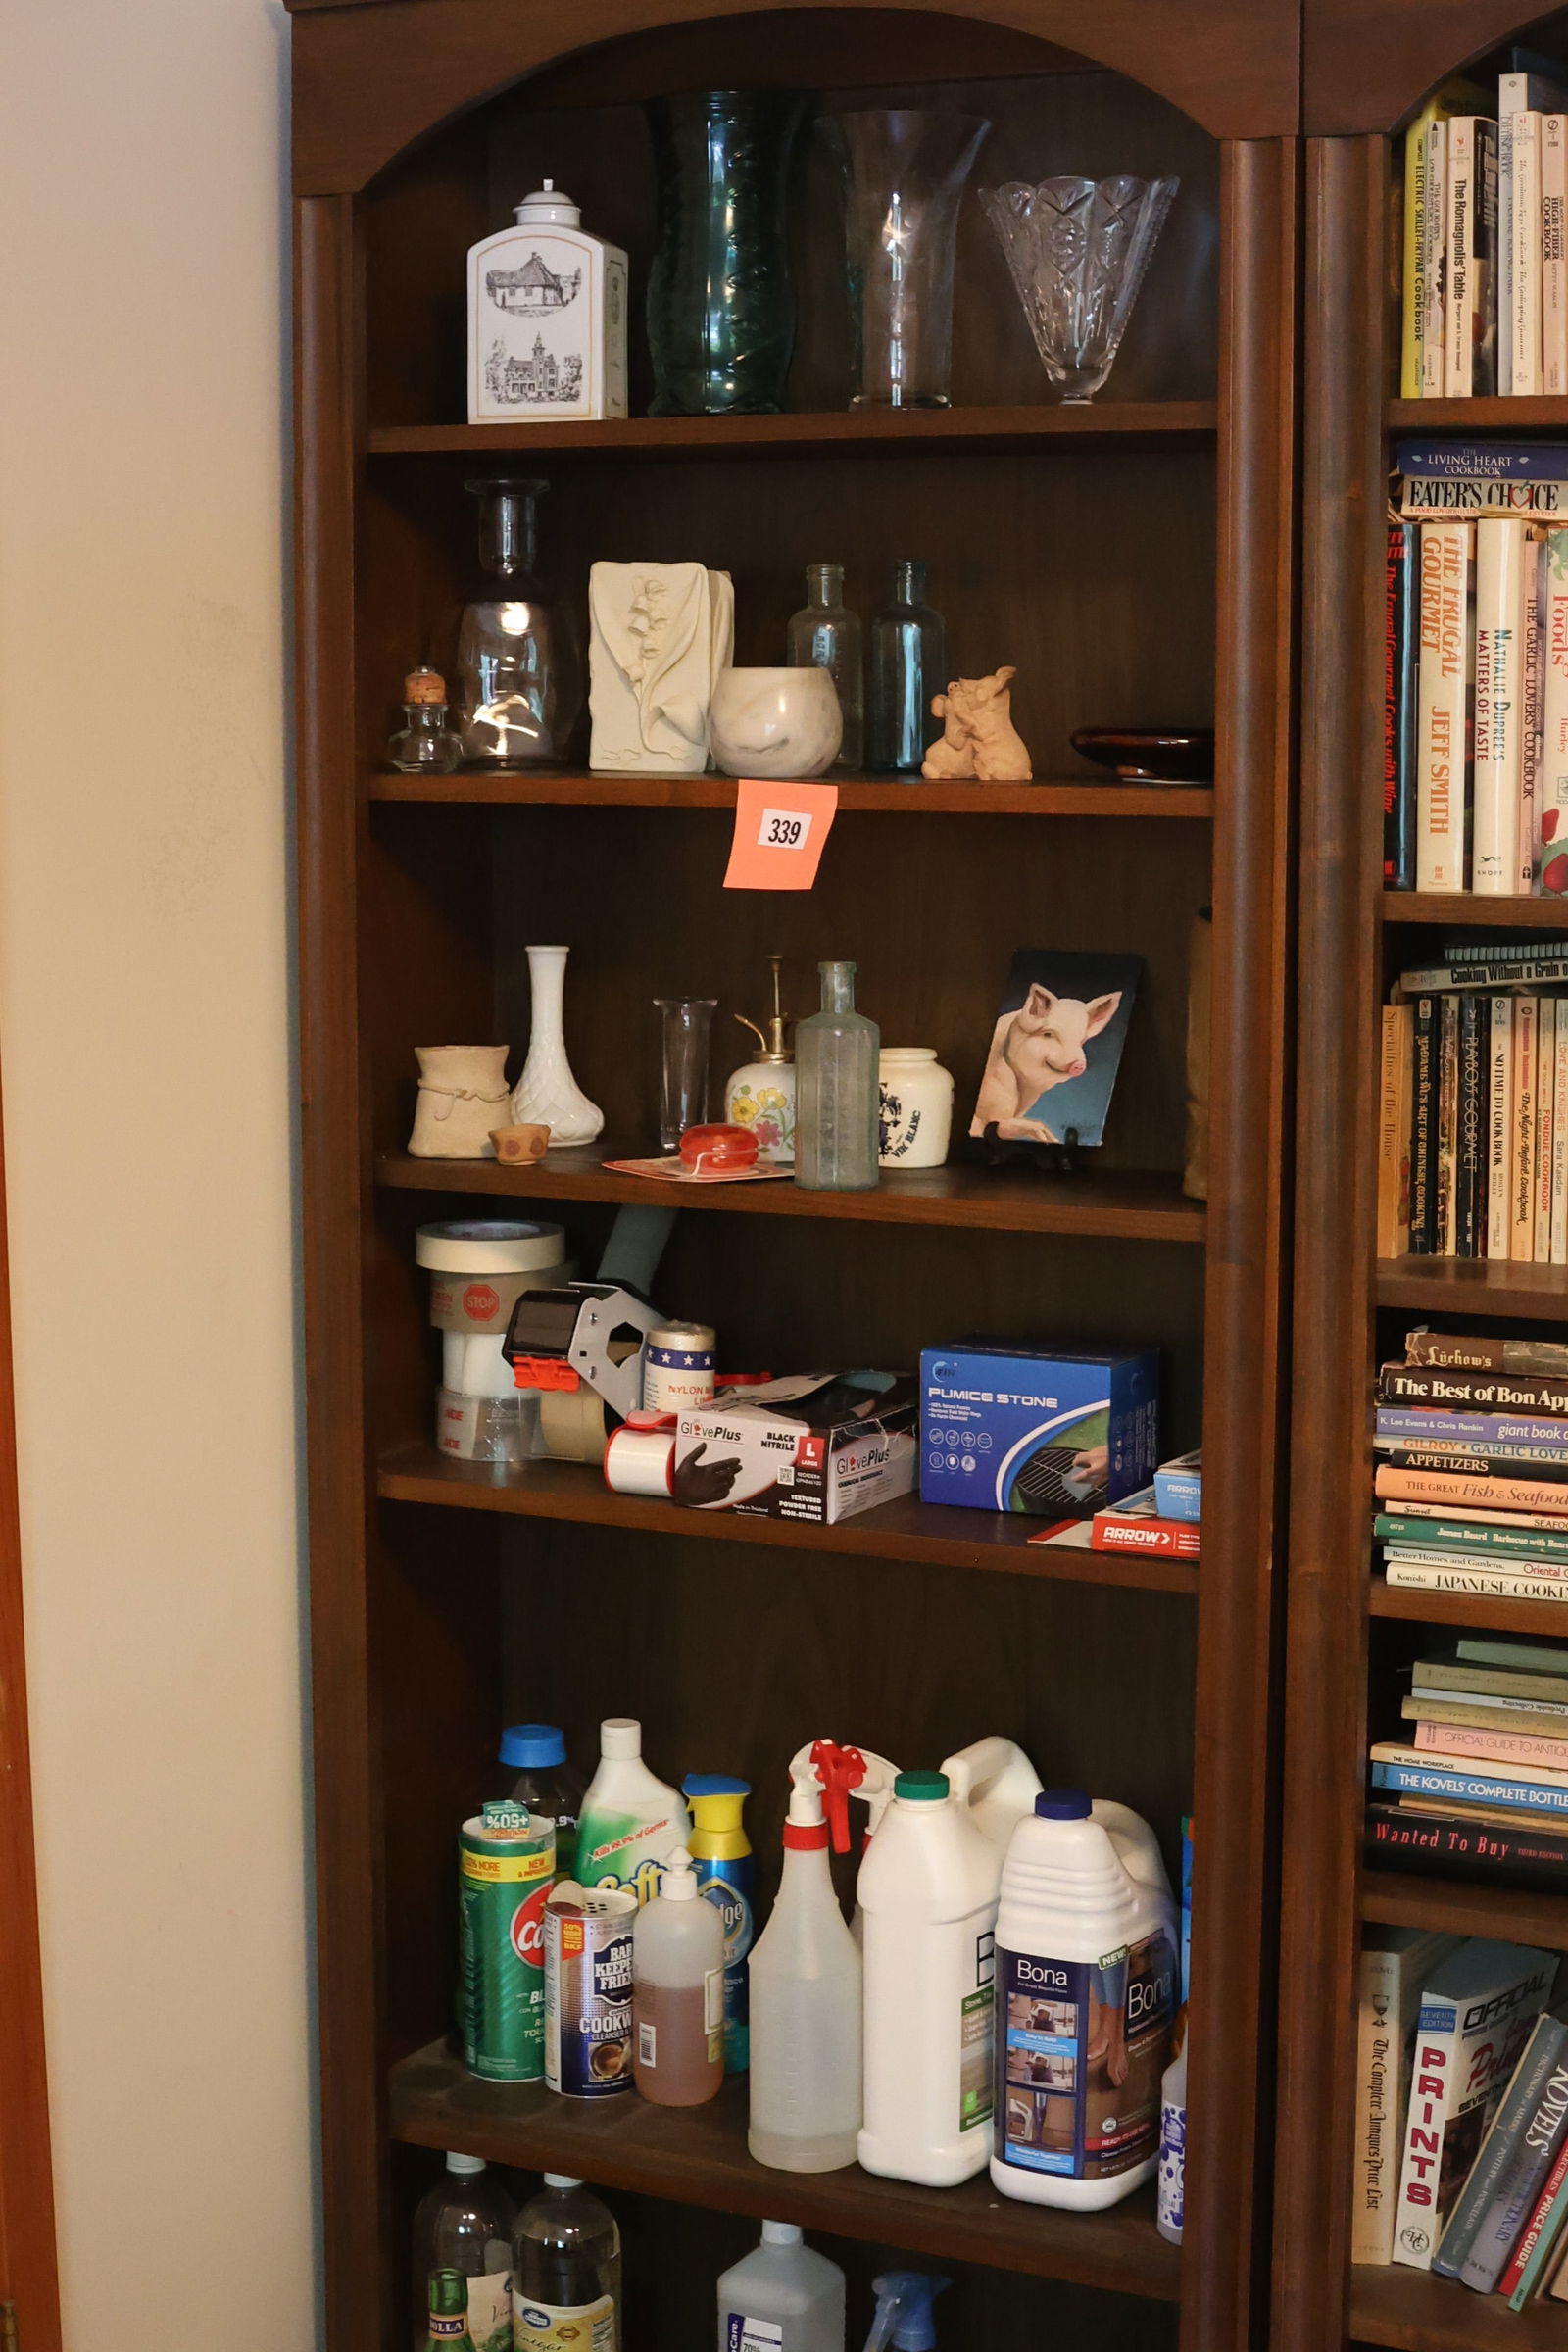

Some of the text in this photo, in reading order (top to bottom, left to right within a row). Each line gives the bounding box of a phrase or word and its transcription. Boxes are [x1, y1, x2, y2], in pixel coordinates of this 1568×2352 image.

[1452, 179, 1467, 300] The Romagnolis' Table
[1414, 165, 1425, 342] ELECTRIC SKILLET-FRYPAN Cookbook
[1428, 455, 1513, 467] LIVING HEART
[1444, 466, 1501, 476] COOKBOOK
[1409, 481, 1482, 508] EATER'S
[1422, 536, 1442, 654] GOURMET
[1442, 535, 1463, 679] THE FRUGAL
[1384, 566, 1396, 814] The Frugal Gourmet Cooks with Wine
[1477, 630, 1489, 760] MATTERS OF TASTE
[1493, 629, 1512, 760] NATHALIE DUPREE'S
[1523, 596, 1538, 800] THE GARLIC LOVERS' COOKBOOK
[1430, 705, 1450, 833] JEFF SMITH
[768, 818, 802, 844] 339
[1451, 962, 1559, 984] Cooking Without a Grain
[1415, 1035, 1429, 1080] MADAME
[1384, 1012, 1398, 1160] Specialties of the House
[1417, 1105, 1428, 1126] ART
[1494, 1054, 1505, 1167] NO TIME TO COOK BOOK
[891, 1110, 921, 1158] VIN BLANC
[1418, 1127, 1428, 1141] OF
[1464, 1098, 1478, 1173] GOURMET
[1516, 1092, 1532, 1226] The Night Before Cookbook
[1556, 1140, 1565, 1159] Sara
[1414, 1142, 1427, 1184] CHINESE
[1555, 1163, 1564, 1196] Kasdan
[1411, 1185, 1426, 1231] COOKING
[466, 1296, 495, 1309] STOP
[668, 1385, 703, 1395] NYLON
[928, 1387, 1058, 1408] PUMICE STONE
[1394, 1377, 1428, 1396] The
[1431, 1380, 1472, 1400] Best
[1474, 1386, 1495, 1402] of
[1496, 1386, 1535, 1405] Bon
[766, 1432, 796, 1444] BLACK
[1405, 1418, 1428, 1428] Evans
[1437, 1421, 1456, 1430] Chris
[1457, 1423, 1484, 1432] Rankin
[1496, 1424, 1529, 1439] giant
[1531, 1424, 1561, 1440] book
[760, 1440, 796, 1452] NITRILE
[806, 1443, 815, 1457] L
[1403, 1438, 1458, 1450] GILROY
[1471, 1443, 1527, 1457] GARLIC
[1405, 1453, 1490, 1472] APPETIZERS
[790, 1494, 822, 1504] TEXTURED
[1405, 1481, 1494, 1498] THE GREAT Fish
[778, 1499, 822, 1513] POWDER FREE
[780, 1509, 822, 1521] NON-STERILE
[1403, 1505, 1431, 1515] Sunset
[1103, 1526, 1160, 1544] ARROW
[1392, 1550, 1466, 1565] Better Homes and
[1523, 1562, 1560, 1577] Oriental
[1396, 1572, 1510, 1593] Konishi JAPANESE
[1444, 1731, 1484, 1746] OFFICIAL
[1486, 1736, 1516, 1748] GUIDE
[1519, 1740, 1532, 1752] TO
[1422, 1760, 1455, 1770] WORKPLACE
[1398, 1772, 1568, 1808] THE KOVELS' COMPLETE BOTTLE
[1376, 1823, 1510, 1861] Wanted To Buy
[478, 1860, 501, 1871] MORE
[528, 1857, 545, 1869] NEW
[1017, 1959, 1068, 1986] Bona
[1128, 1971, 1172, 2019] Bona
[1463, 1971, 1546, 2030] OFFICIAL
[1420, 2010, 1456, 2020] SEVENTH
[1422, 2019, 1454, 2029] EDITION
[1364, 2038, 1390, 2209] The Complete Price List
[1406, 2046, 1446, 2206] PRINTS
[1489, 2147, 1507, 2180] POTTERY
[1532, 2193, 1554, 2230] PRICE
[1514, 2230, 1538, 2269] GUIDE
